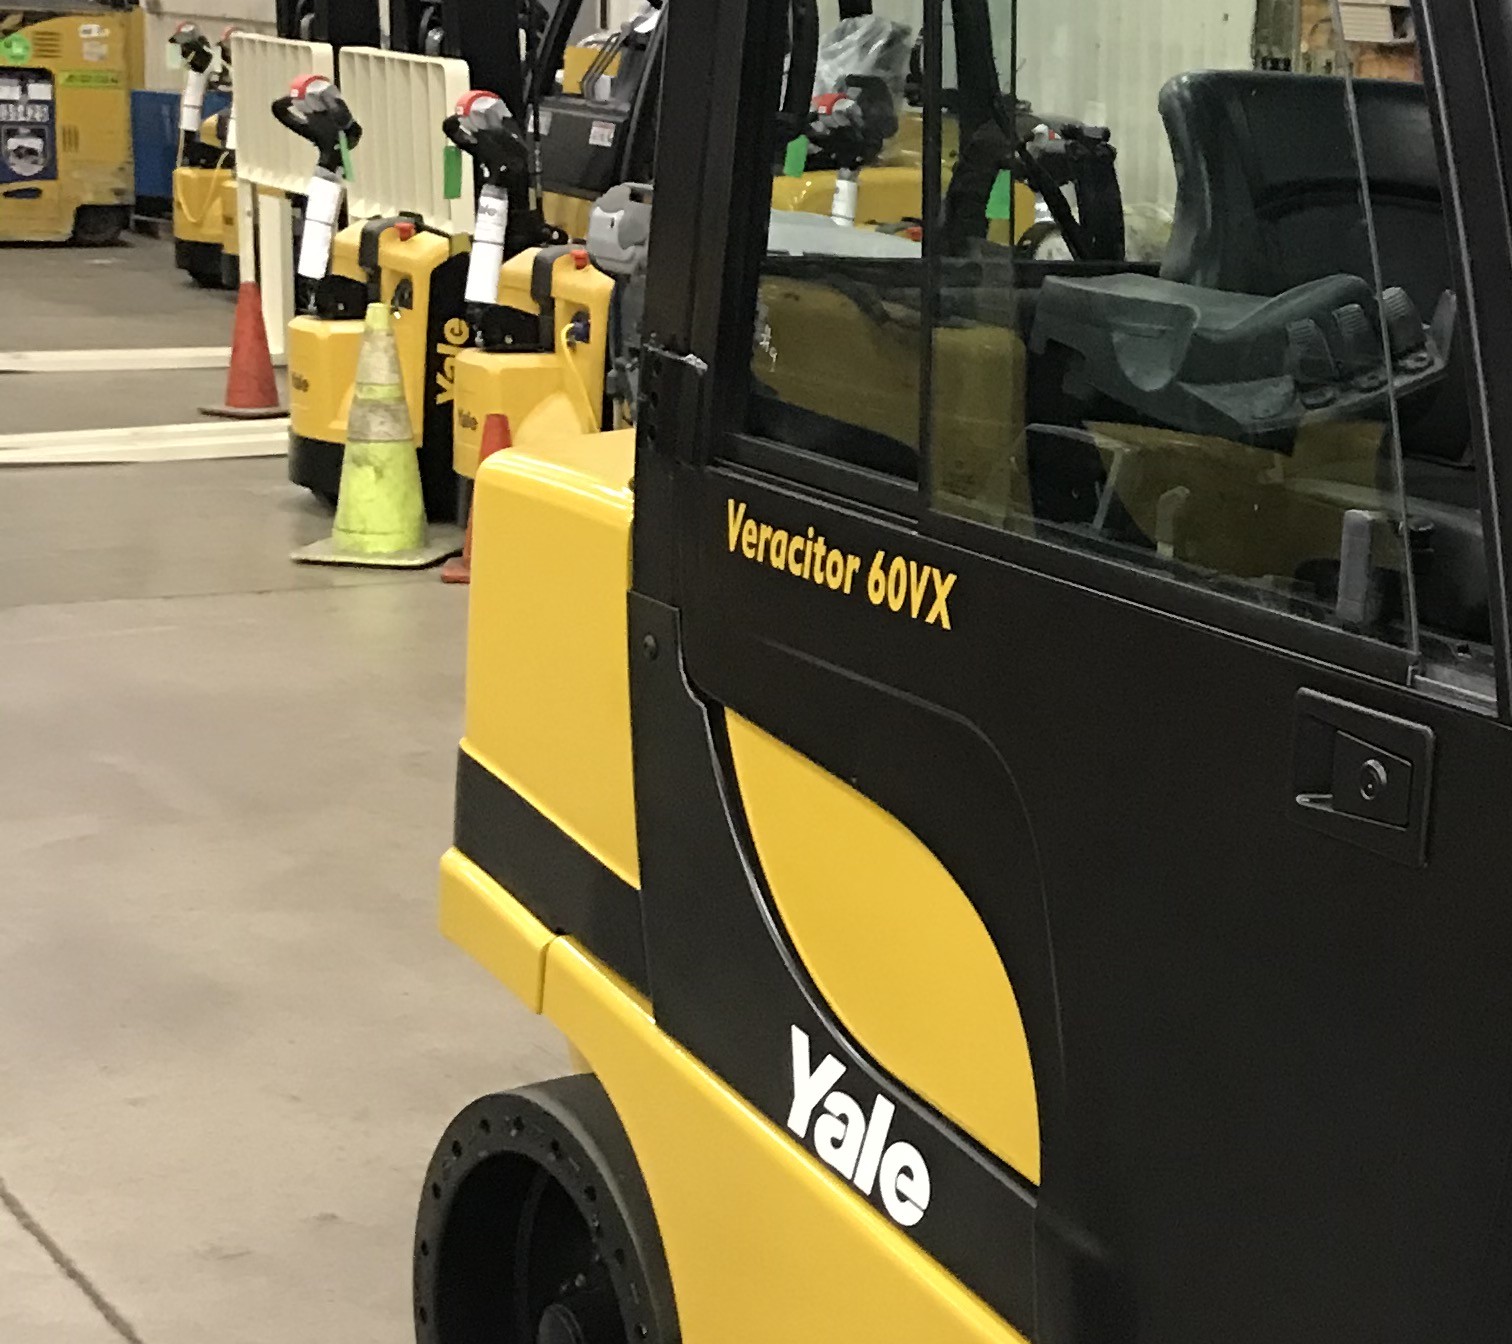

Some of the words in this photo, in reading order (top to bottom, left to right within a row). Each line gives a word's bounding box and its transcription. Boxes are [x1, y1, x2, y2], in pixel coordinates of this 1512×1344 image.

[727, 498, 861, 594] Veracitor
[867, 550, 957, 631] 60VX
[786, 1023, 931, 1227] Yale
